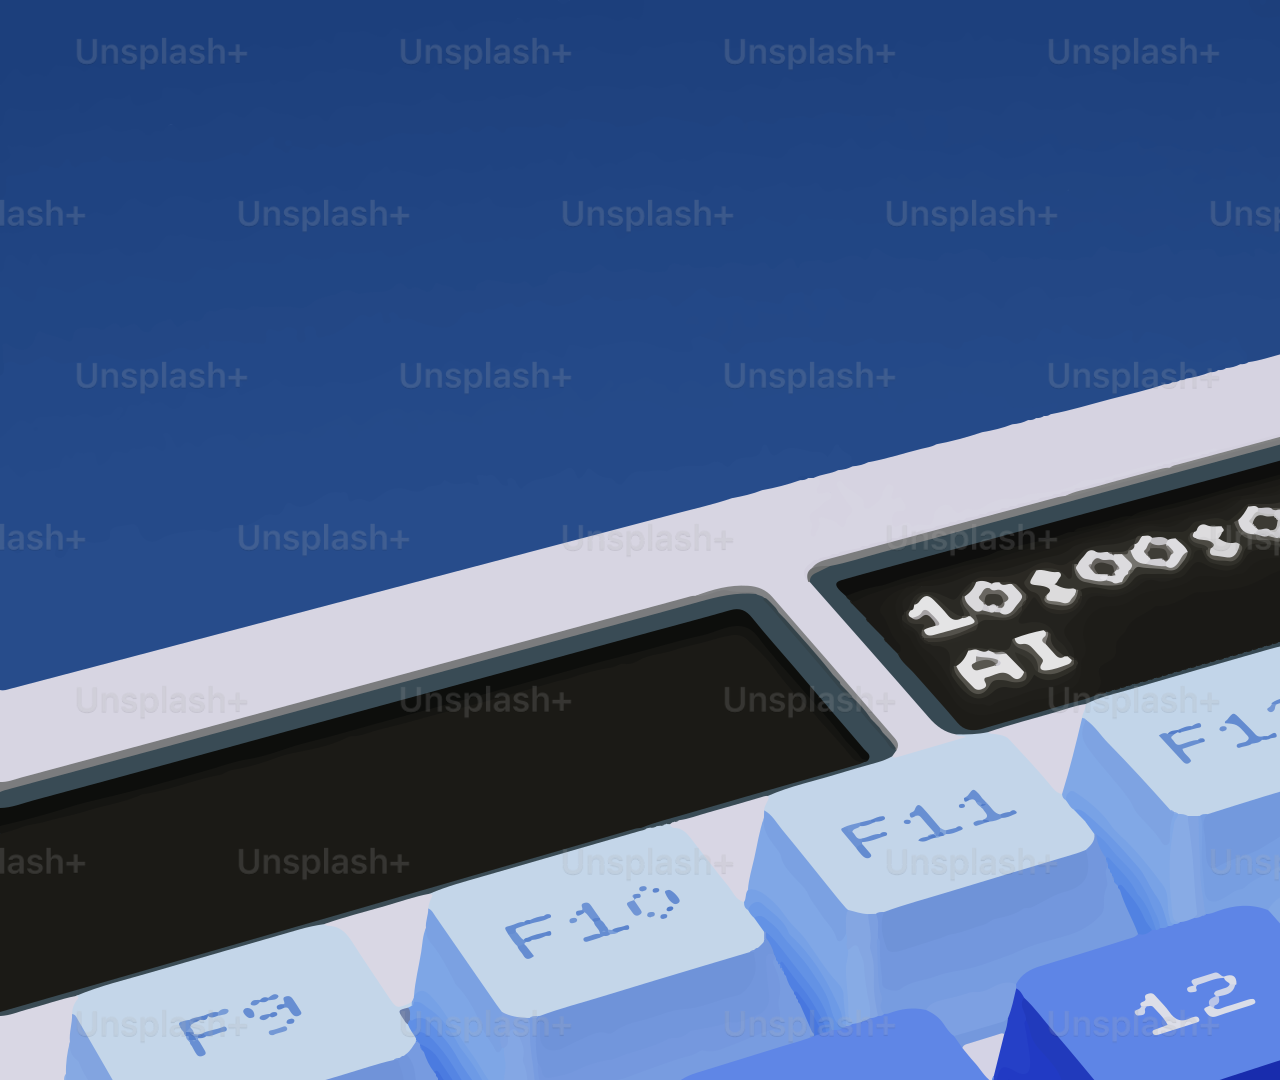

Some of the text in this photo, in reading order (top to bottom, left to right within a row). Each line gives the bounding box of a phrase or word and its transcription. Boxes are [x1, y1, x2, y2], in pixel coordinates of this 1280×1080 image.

[955, 629, 1073, 691] AI
[841, 789, 1018, 859] F11
[504, 885, 681, 960] F10
[179, 993, 302, 1057] F9
[1134, 972, 1256, 1036] 12
